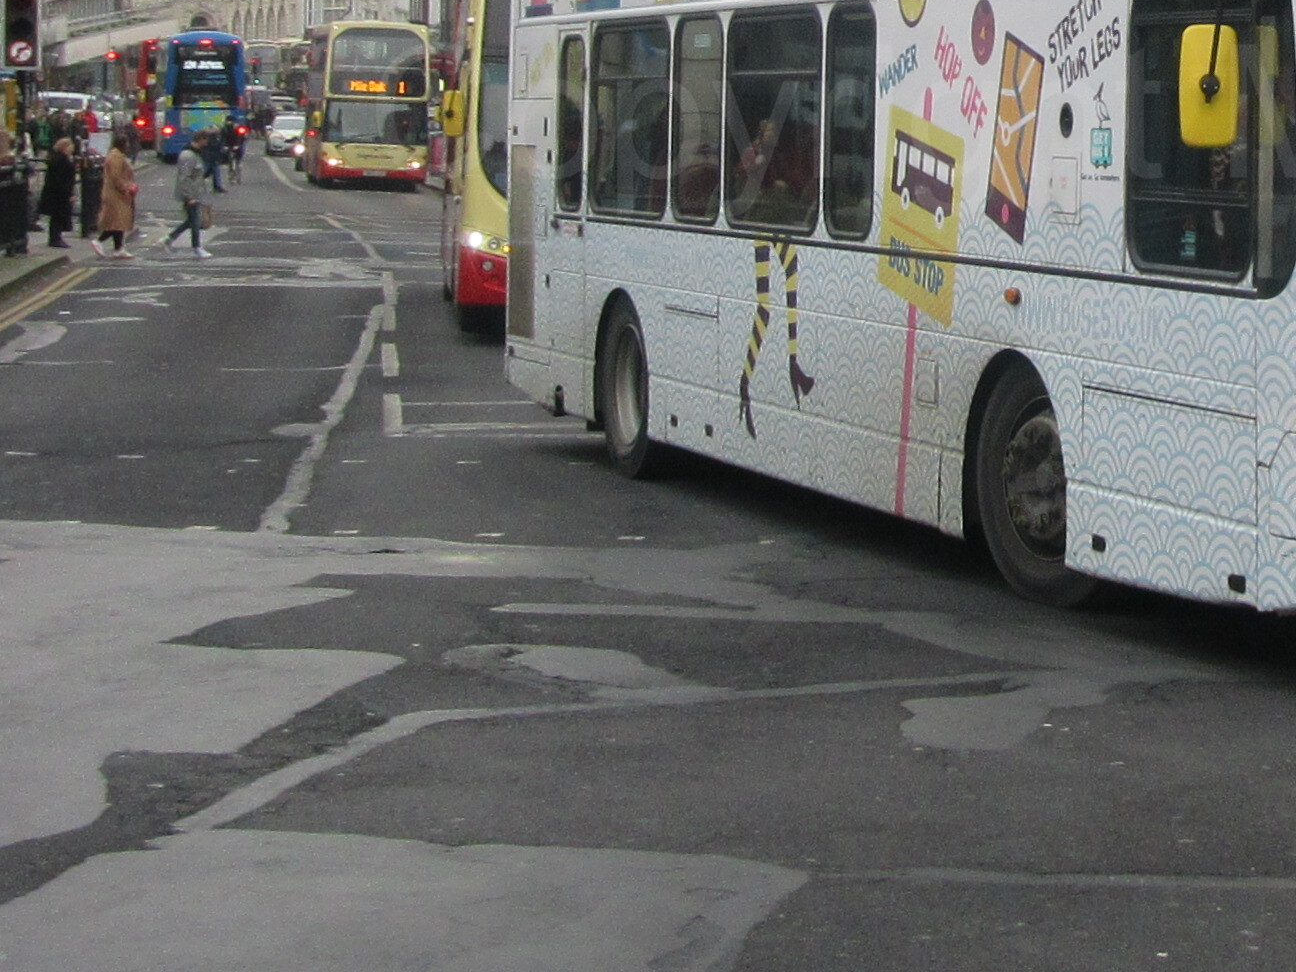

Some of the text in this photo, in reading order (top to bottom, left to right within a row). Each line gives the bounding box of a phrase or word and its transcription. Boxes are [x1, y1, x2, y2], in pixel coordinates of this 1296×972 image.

[878, 43, 919, 100] WANDER
[934, 25, 988, 140] HOP OFF
[1057, 16, 1121, 93] YOUR LEGS
[888, 235, 945, 296] BUS STOP
